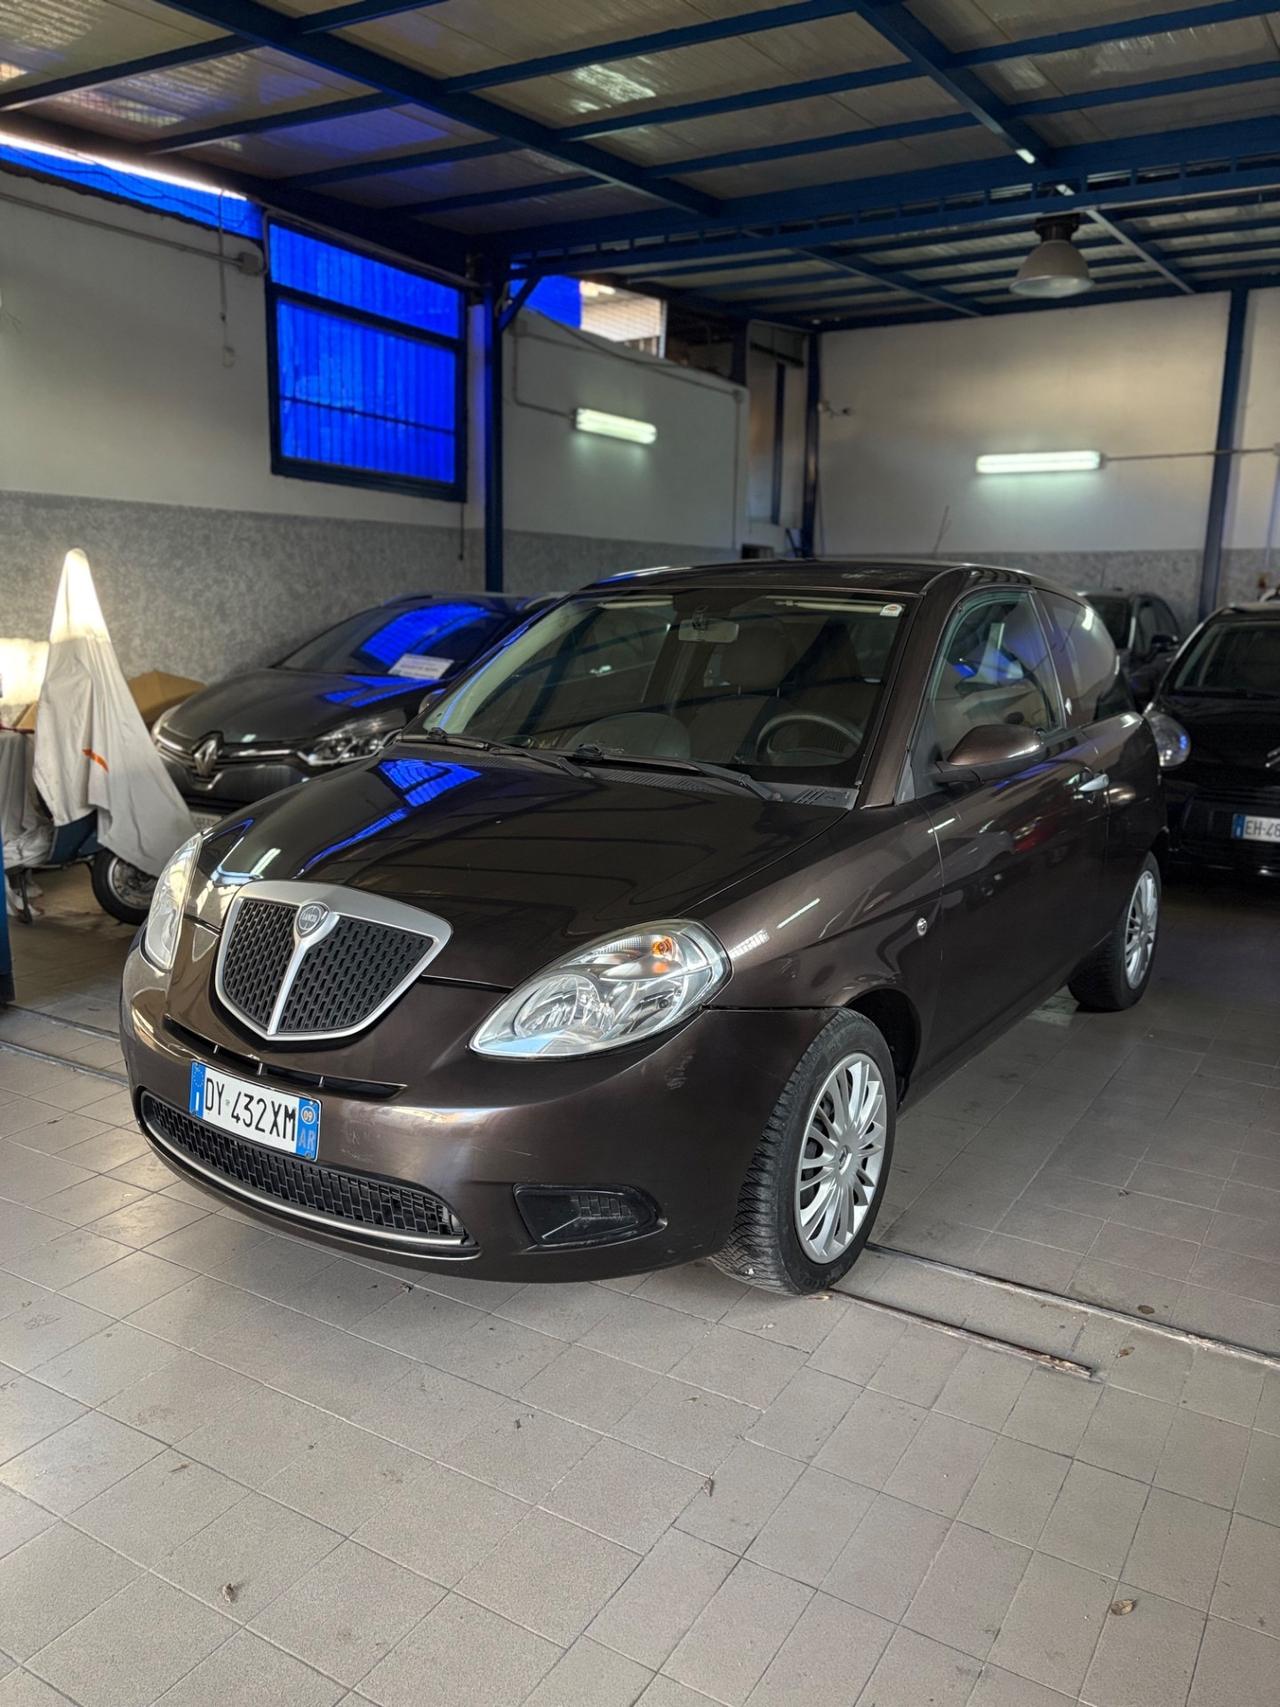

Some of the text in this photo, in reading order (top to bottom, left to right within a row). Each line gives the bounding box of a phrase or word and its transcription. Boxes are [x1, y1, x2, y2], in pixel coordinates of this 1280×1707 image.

[1245, 820, 1263, 837] EH
[196, 1092, 200, 1111] I
[205, 1078, 297, 1142] DY 432XM
[303, 1110, 313, 1122] 09
[298, 1127, 316, 1152] AR
